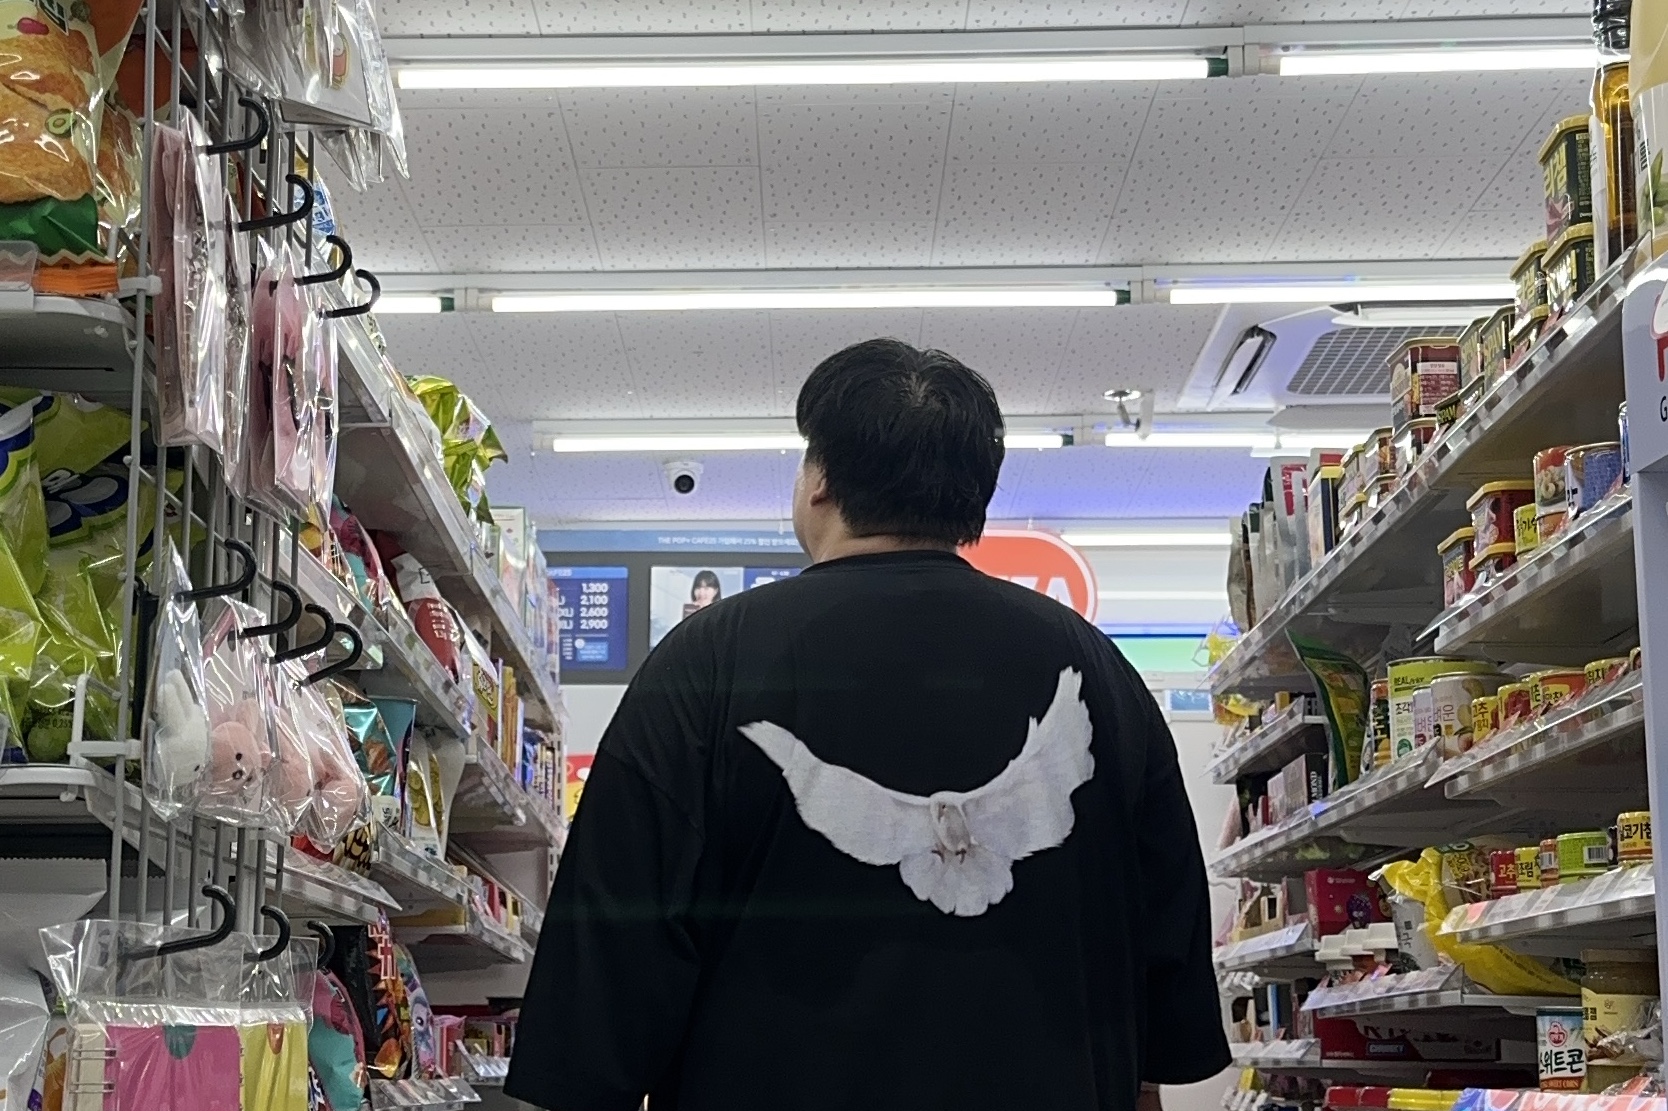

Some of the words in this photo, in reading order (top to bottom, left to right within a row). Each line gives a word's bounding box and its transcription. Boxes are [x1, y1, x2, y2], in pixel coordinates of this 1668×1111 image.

[580, 595, 609, 606] 2,100
[580, 607, 609, 617] 2,600
[580, 619, 609, 630] 2,900
